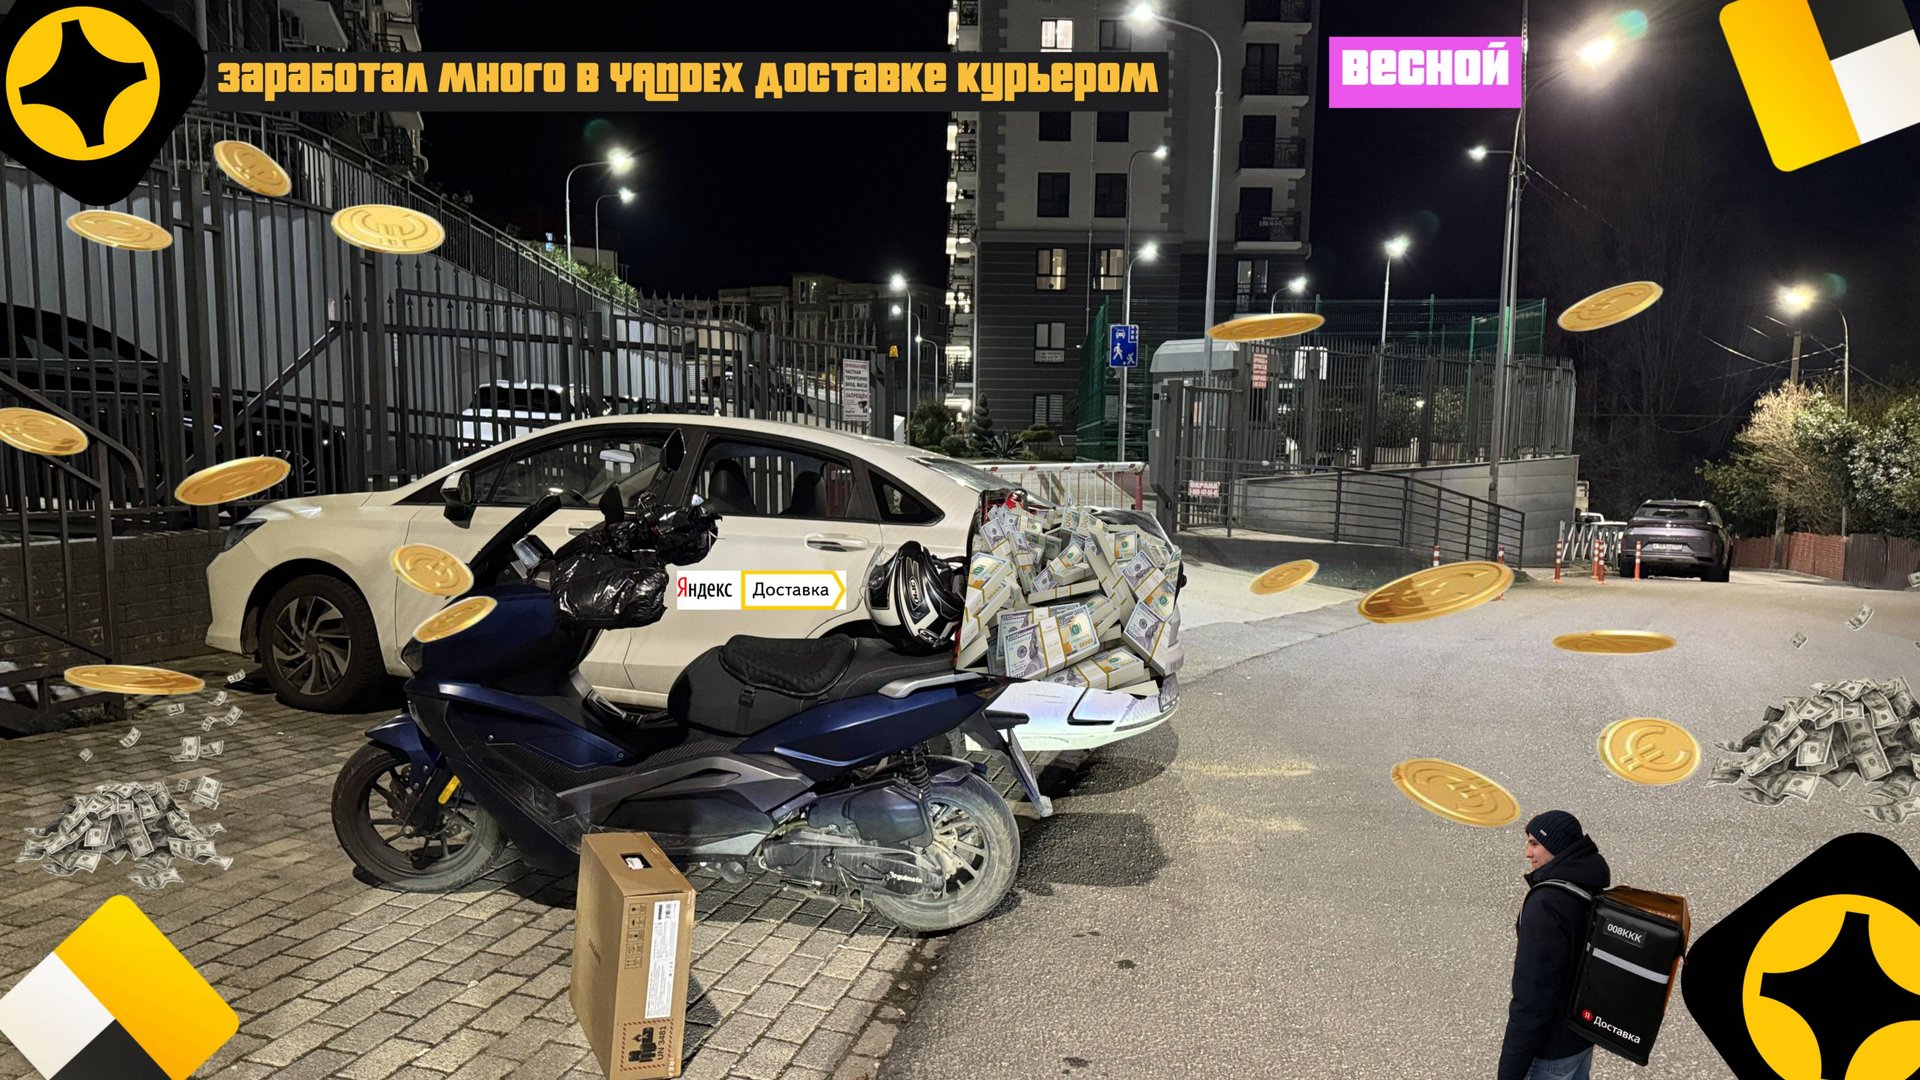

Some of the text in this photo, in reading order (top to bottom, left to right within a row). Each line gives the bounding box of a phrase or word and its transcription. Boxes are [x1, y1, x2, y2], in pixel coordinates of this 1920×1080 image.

[657, 1025, 667, 1060] UN 3481
[1593, 1015, 1641, 1044] Доставка
